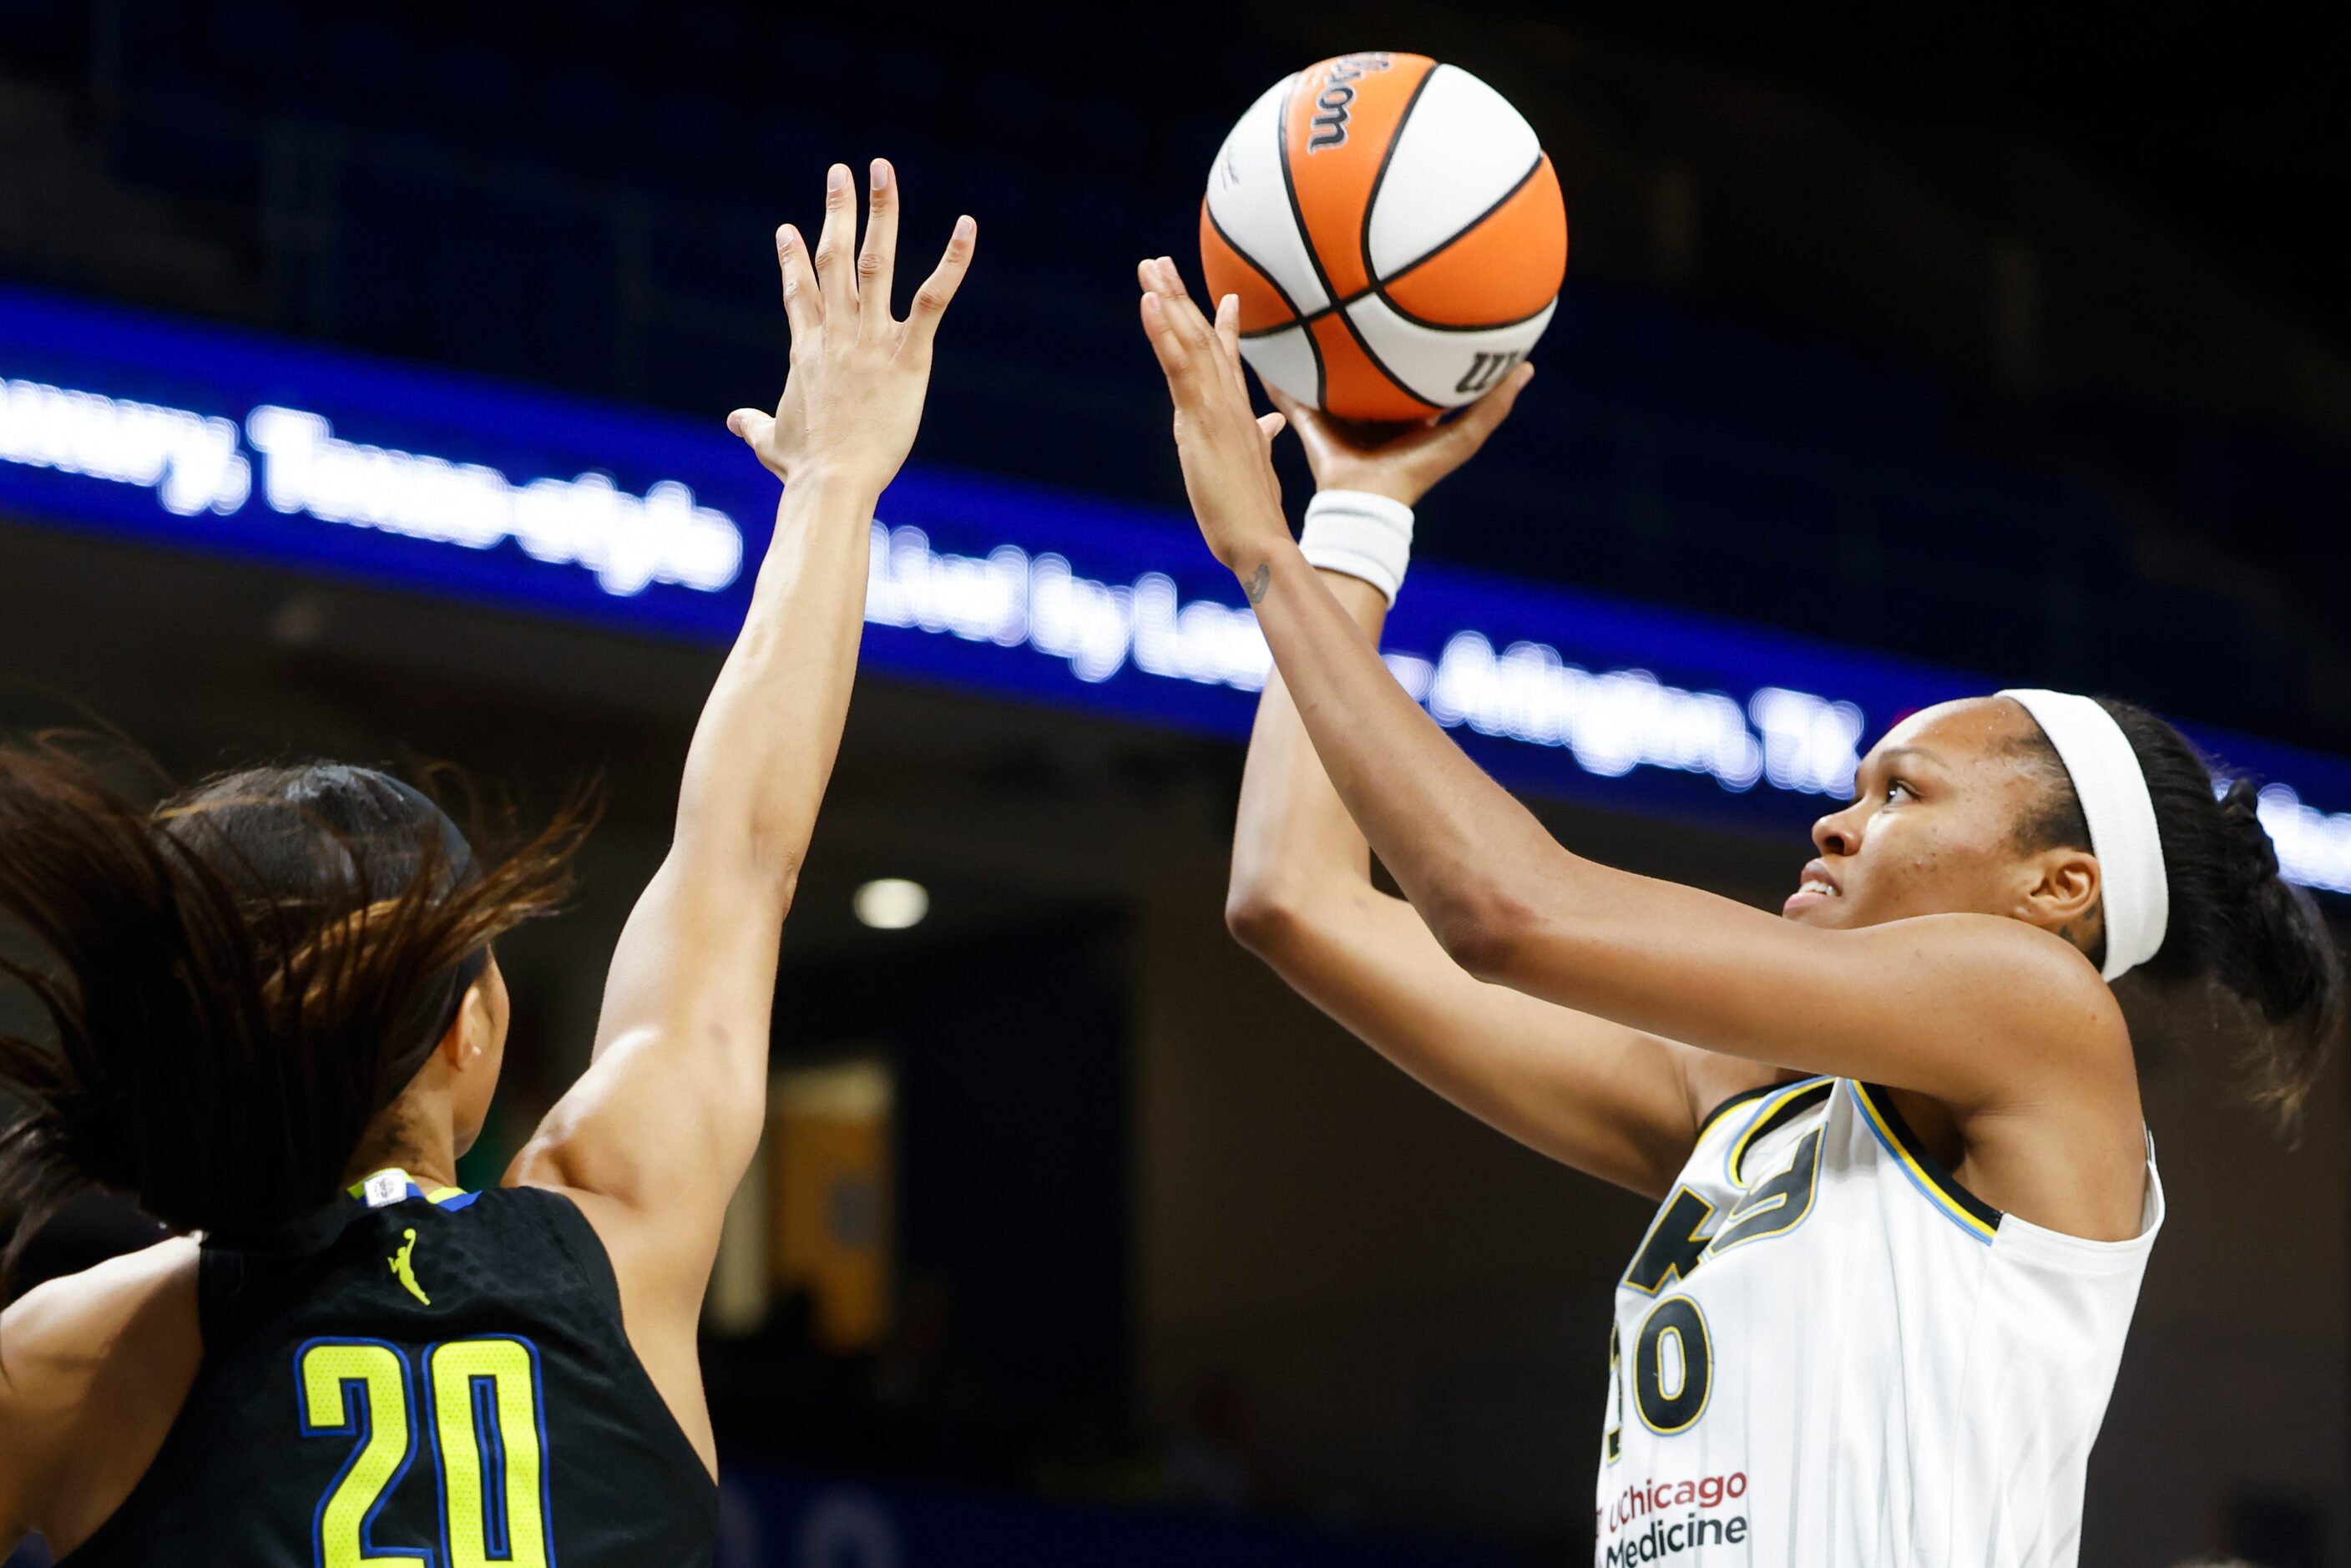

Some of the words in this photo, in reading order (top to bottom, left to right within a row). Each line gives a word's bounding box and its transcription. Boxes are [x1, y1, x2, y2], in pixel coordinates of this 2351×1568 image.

[294, 1333, 556, 1568] 20
[1610, 1472, 1747, 1533] UChicago
[1605, 1512, 1747, 1568] Medicine
